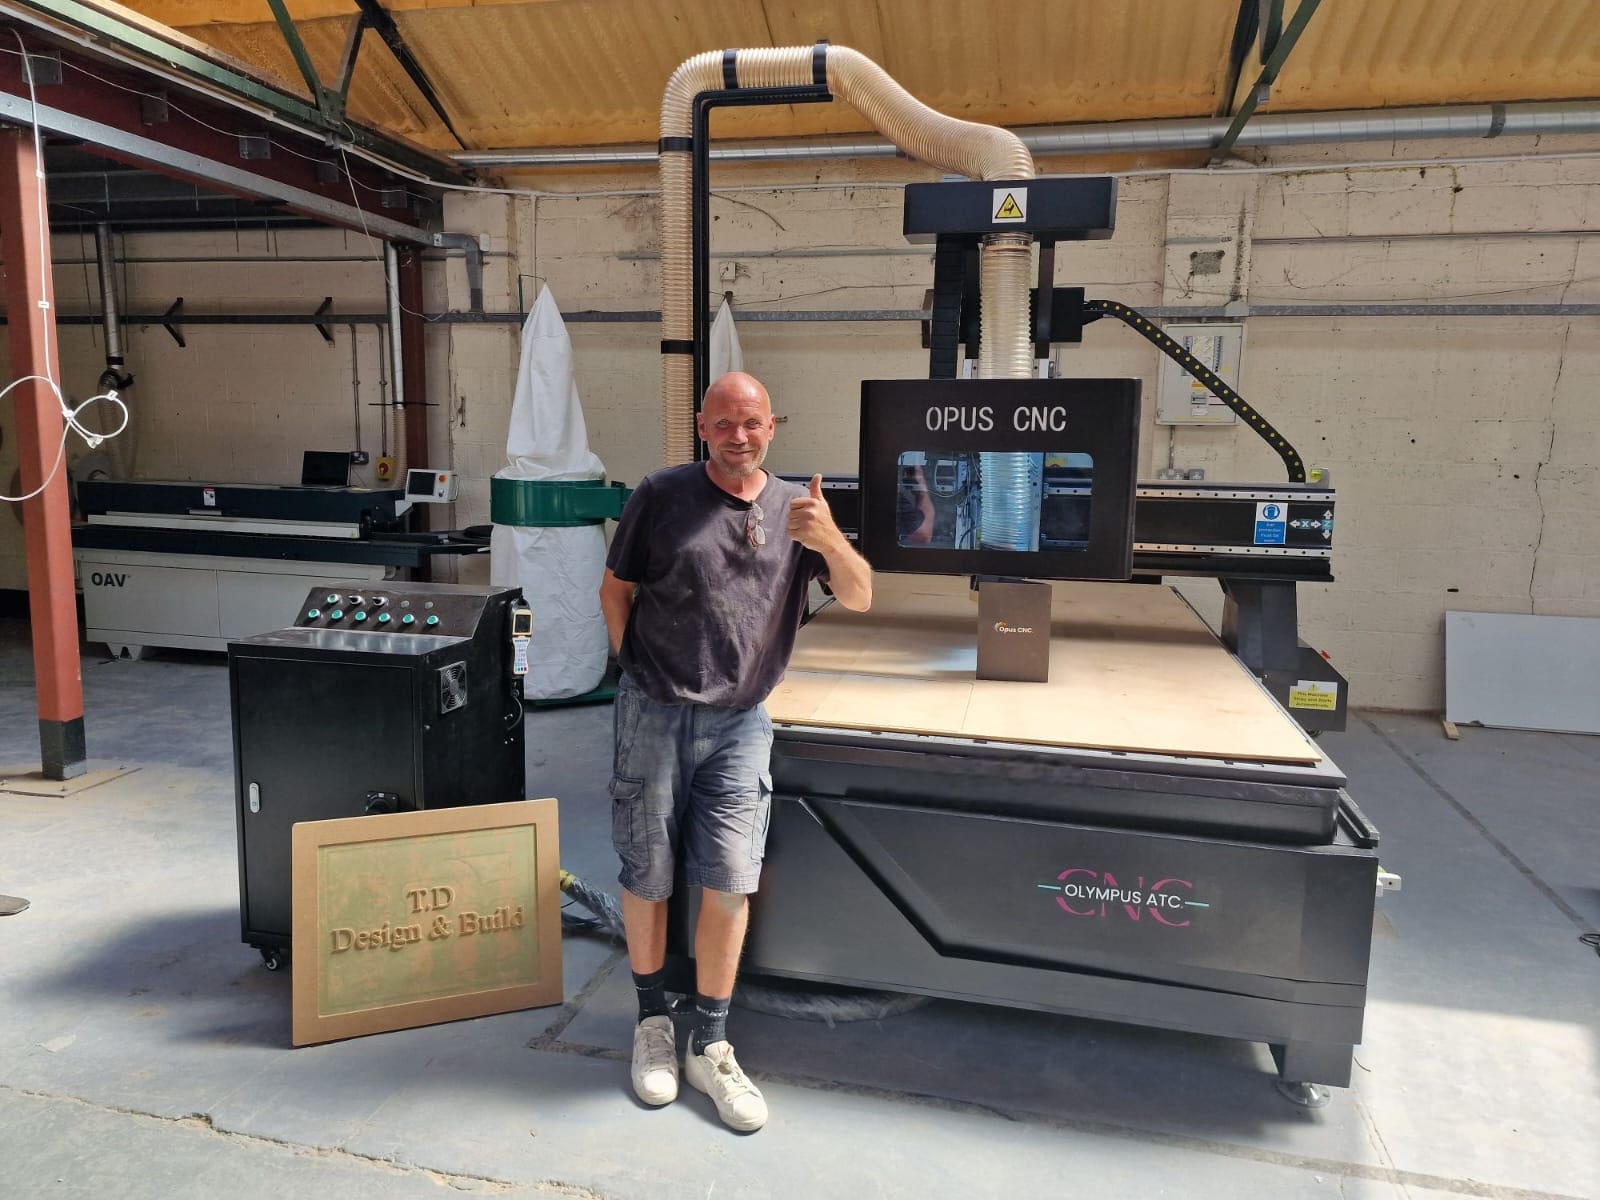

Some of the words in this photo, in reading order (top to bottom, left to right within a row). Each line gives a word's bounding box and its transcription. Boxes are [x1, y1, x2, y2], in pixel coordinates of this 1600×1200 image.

[925, 406, 994, 432] OPUS
[1013, 406, 1067, 432] CNC
[1301, 520, 1309, 528] X
[1323, 520, 1332, 528] Z
[91, 572, 126, 587] OAV
[999, 626, 1016, 634] Opus
[1065, 884, 1142, 904] OLYMPUS
[331, 921, 423, 954] Design
[428, 914, 454, 940] &
[458, 904, 526, 936] Build
